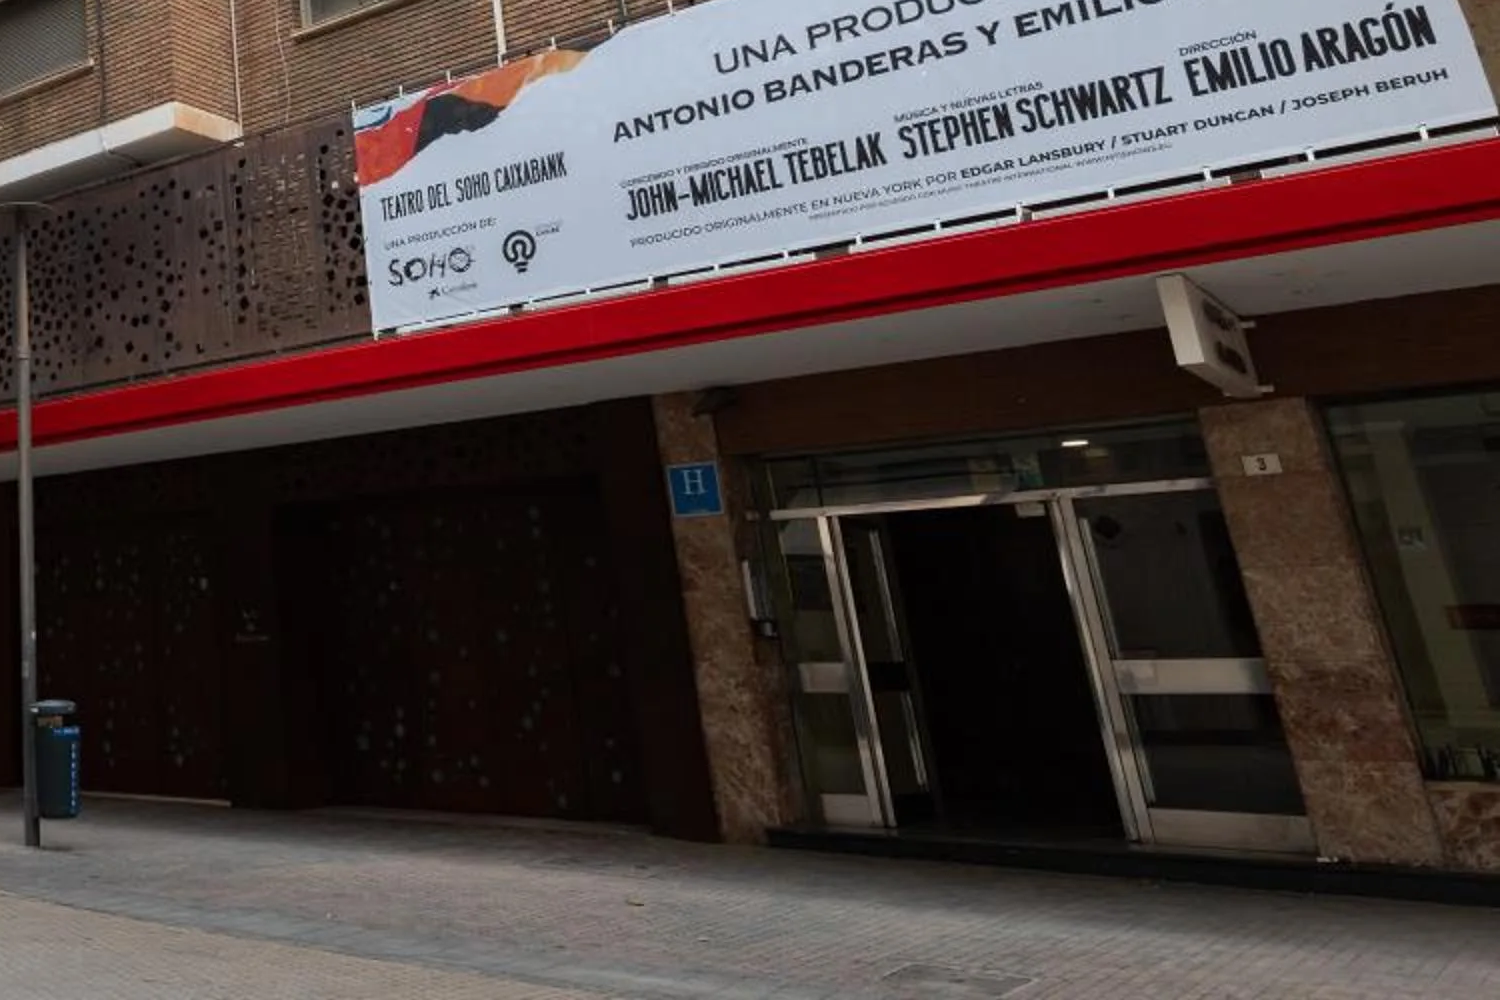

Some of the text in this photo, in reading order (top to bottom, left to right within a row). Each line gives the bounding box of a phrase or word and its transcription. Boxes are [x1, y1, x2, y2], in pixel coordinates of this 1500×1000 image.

[713, 34, 797, 75] UNA
[1179, 30, 1257, 56] DIRECCIÓN
[613, 89, 755, 143] ANTONIO
[763, 32, 968, 103] BANDERAS
[976, 21, 1000, 47] Y
[626, 158, 784, 221] JOHN-MICHAEL
[783, 131, 888, 185] TEBELAK
[898, 102, 1015, 159] STEPHEN
[1015, 66, 1173, 133] SCHWARTZ
[1184, 38, 1297, 97] EMILIO
[1300, 2, 1437, 73] ARAGÓN
[380, 150, 567, 221] TEATRO DEL SOHO CAIXABANK
[629, 224, 701, 248] PRODUCIDO
[704, 202, 808, 234] ORIGINALMENTE
[811, 199, 831, 210] EN
[833, 187, 881, 205] NUEVA
[882, 178, 924, 195] YORK
[926, 171, 957, 187] POR
[960, 159, 1015, 179] EDGAR
[1018, 139, 1105, 167] LANSBURY
[1121, 121, 1190, 146] STUART
[1194, 102, 1275, 131] DUNCAN
[1290, 83, 1370, 111] JOSEPH
[1375, 67, 1449, 94] BERUH
[388, 247, 474, 287] SOHO
[681, 469, 706, 495] H
